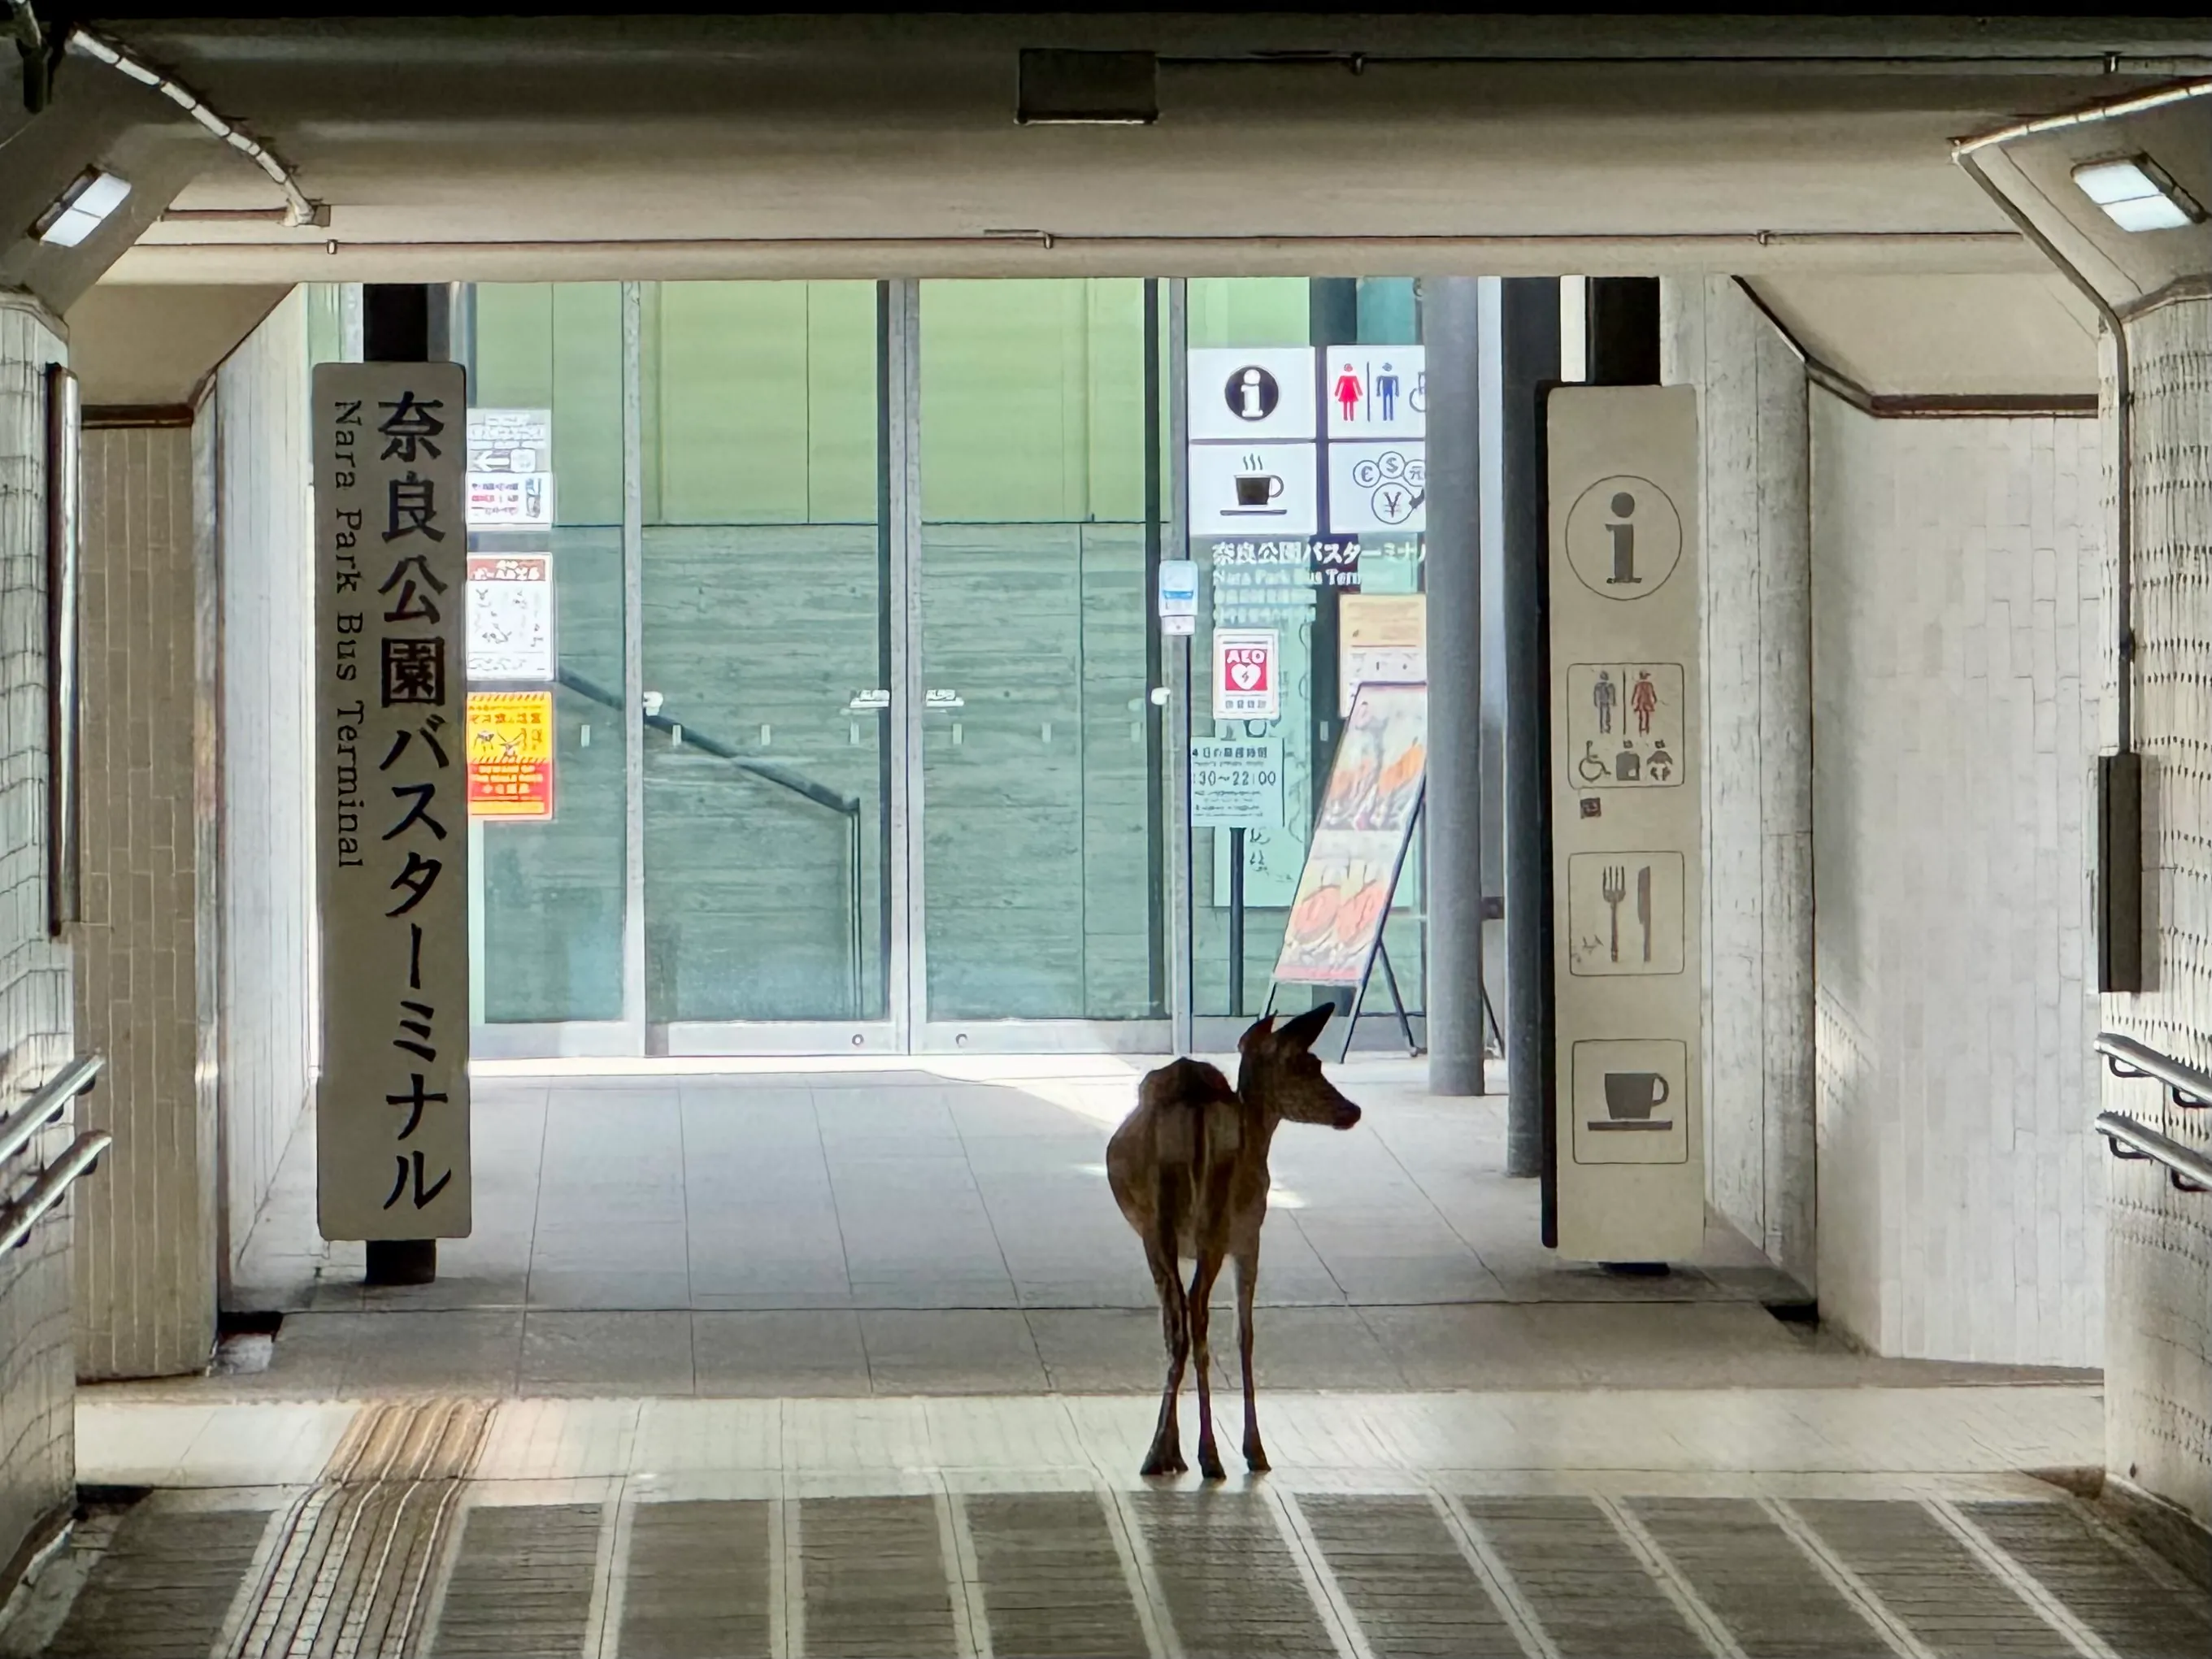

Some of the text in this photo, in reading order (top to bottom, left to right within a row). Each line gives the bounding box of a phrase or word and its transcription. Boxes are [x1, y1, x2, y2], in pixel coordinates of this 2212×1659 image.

[335, 399, 365, 868] Nara Park Bus Terminal
[378, 390, 452, 1211] 奈良公園バスターミナル
